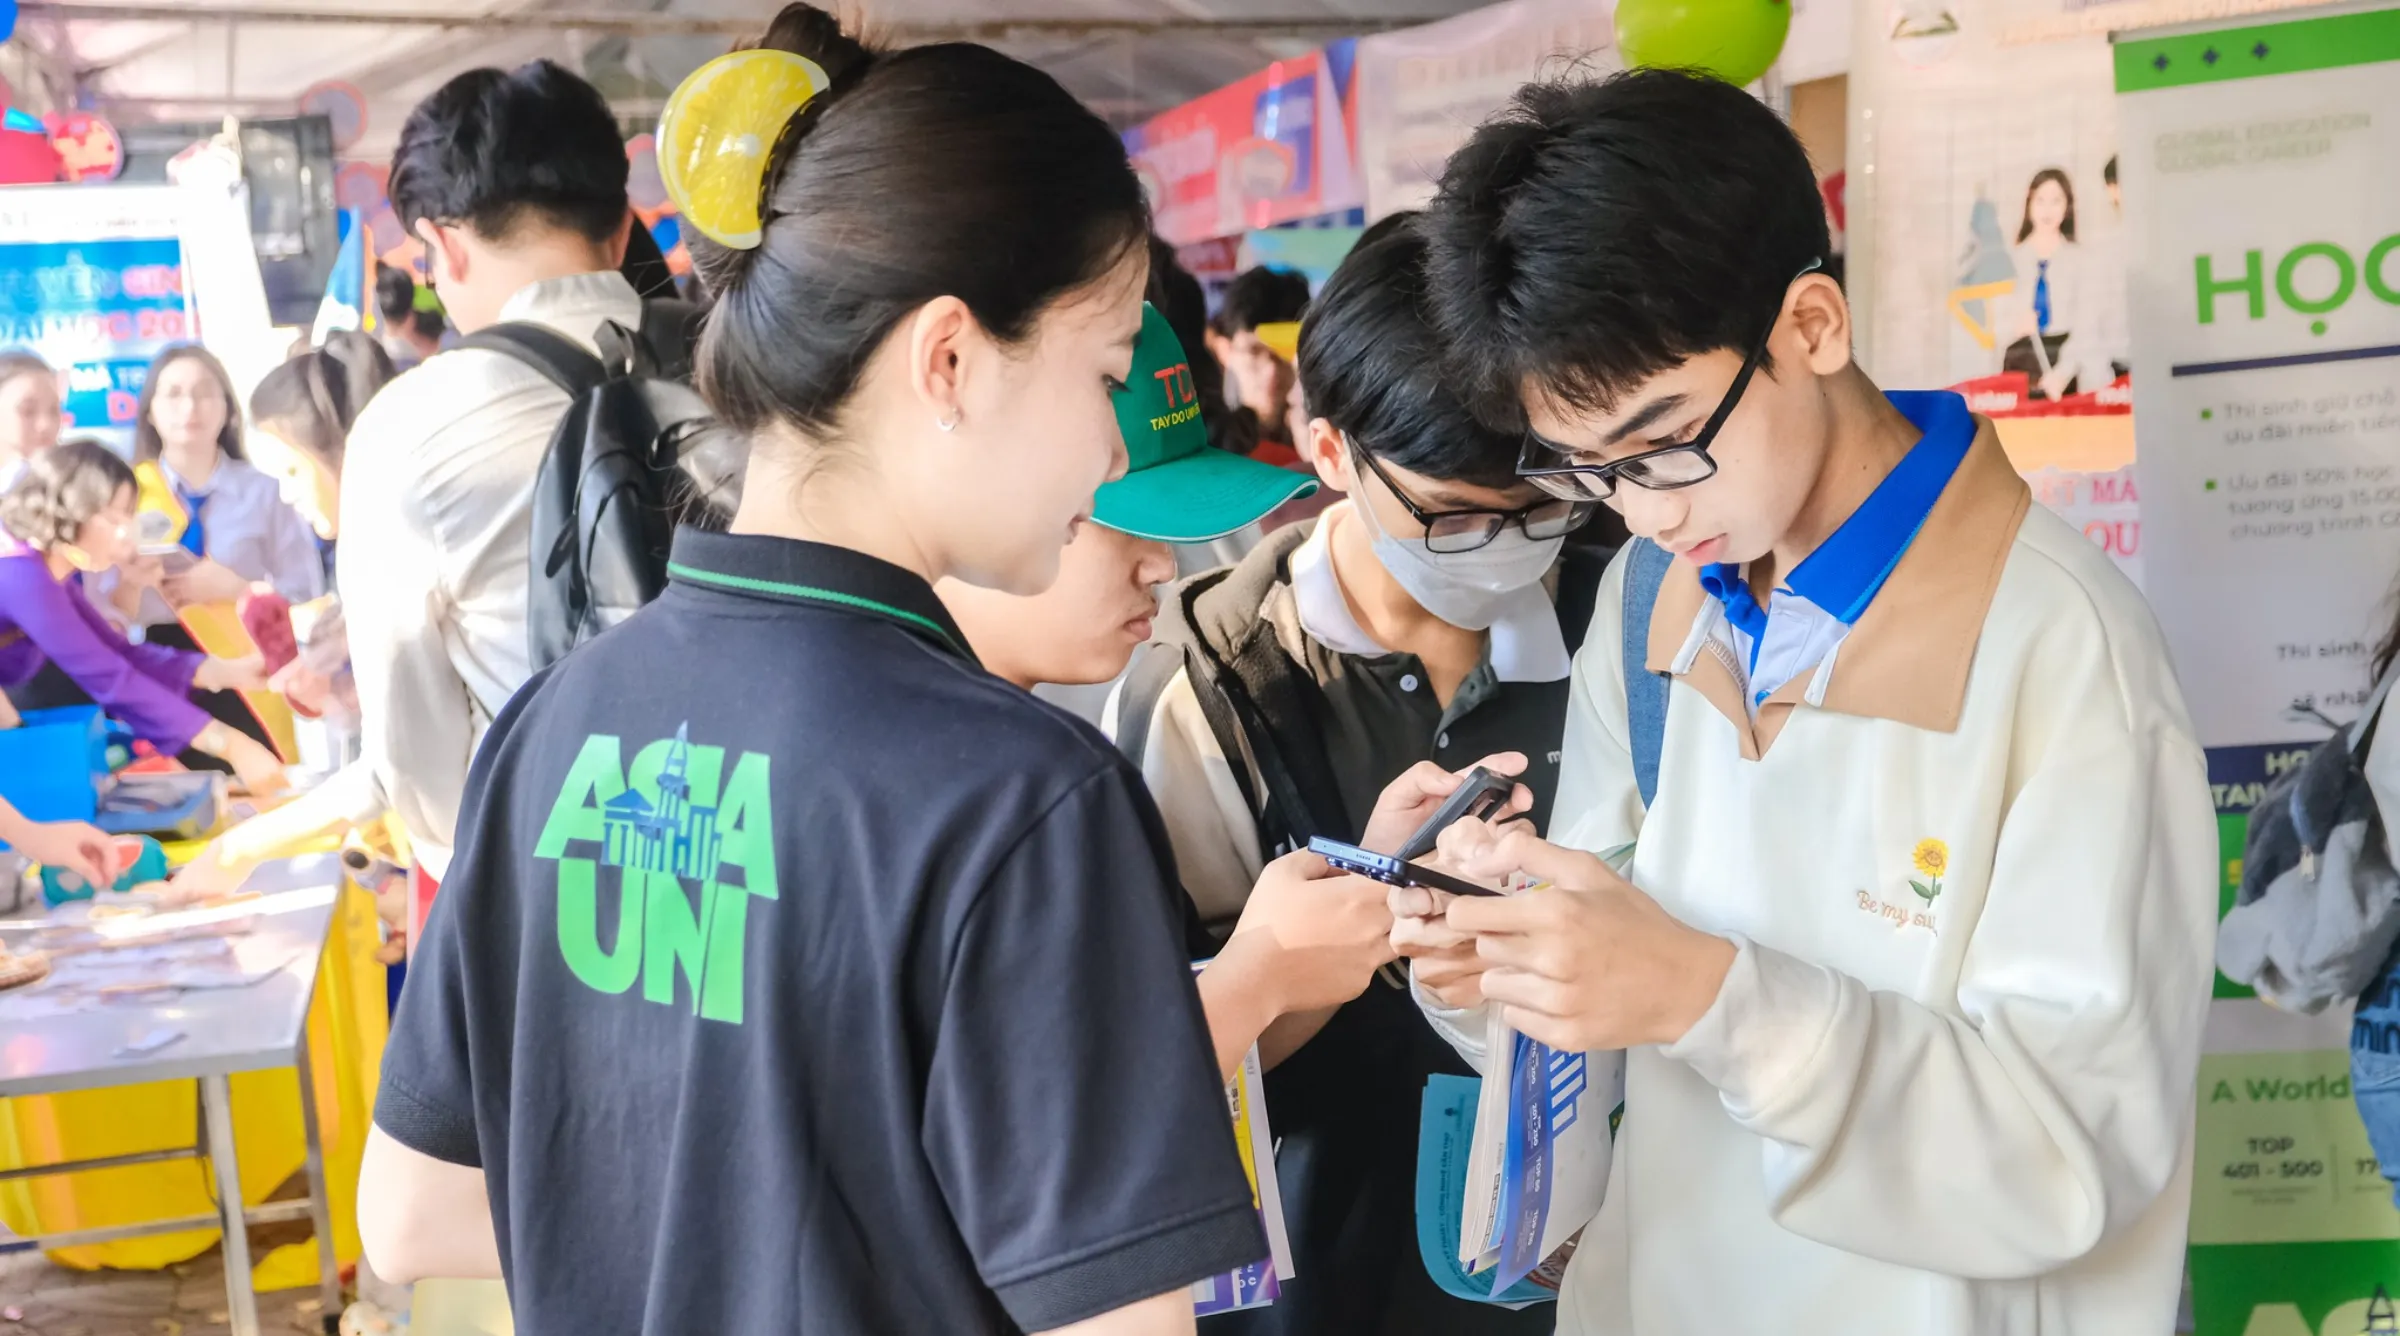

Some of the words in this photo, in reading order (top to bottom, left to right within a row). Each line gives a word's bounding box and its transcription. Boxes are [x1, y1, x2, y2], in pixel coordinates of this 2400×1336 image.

[1150, 414, 1170, 431] TAY
[1171, 410, 1185, 425] DO
[2278, 643, 2310, 660] Thi
[2319, 640, 2367, 657] sinh
[533, 733, 779, 900] ASIA
[1856, 890, 1877, 913] Be
[1881, 902, 1910, 928] my
[557, 857, 748, 1025] UNI
[2211, 1079, 2238, 1104] A
[2246, 1073, 2351, 1102] World
[2248, 1136, 2295, 1154] TOP
